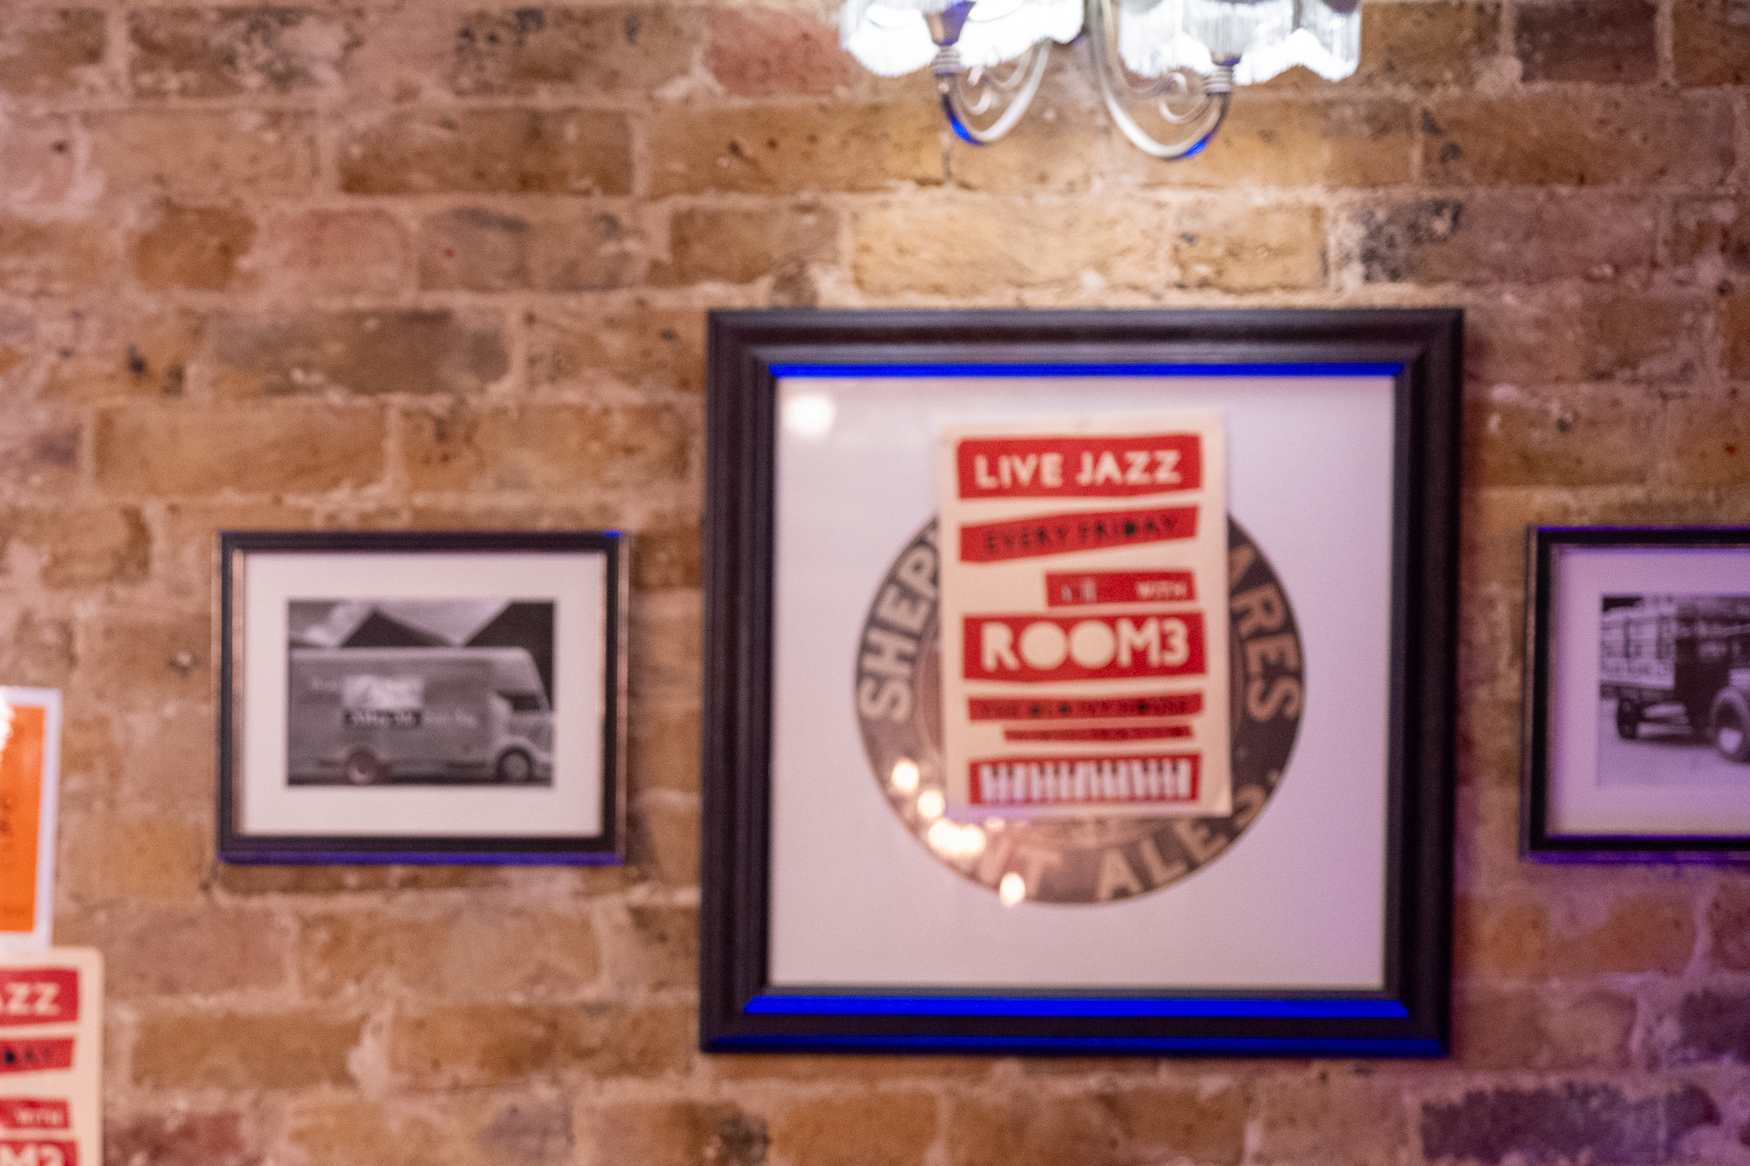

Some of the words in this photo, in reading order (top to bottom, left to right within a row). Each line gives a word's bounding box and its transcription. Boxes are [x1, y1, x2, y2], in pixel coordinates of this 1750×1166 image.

[974, 452, 1063, 489] LIVE
[1076, 449, 1182, 485] JAZZ
[858, 520, 940, 723] SHEP
[981, 618, 1190, 671] ROOM3
